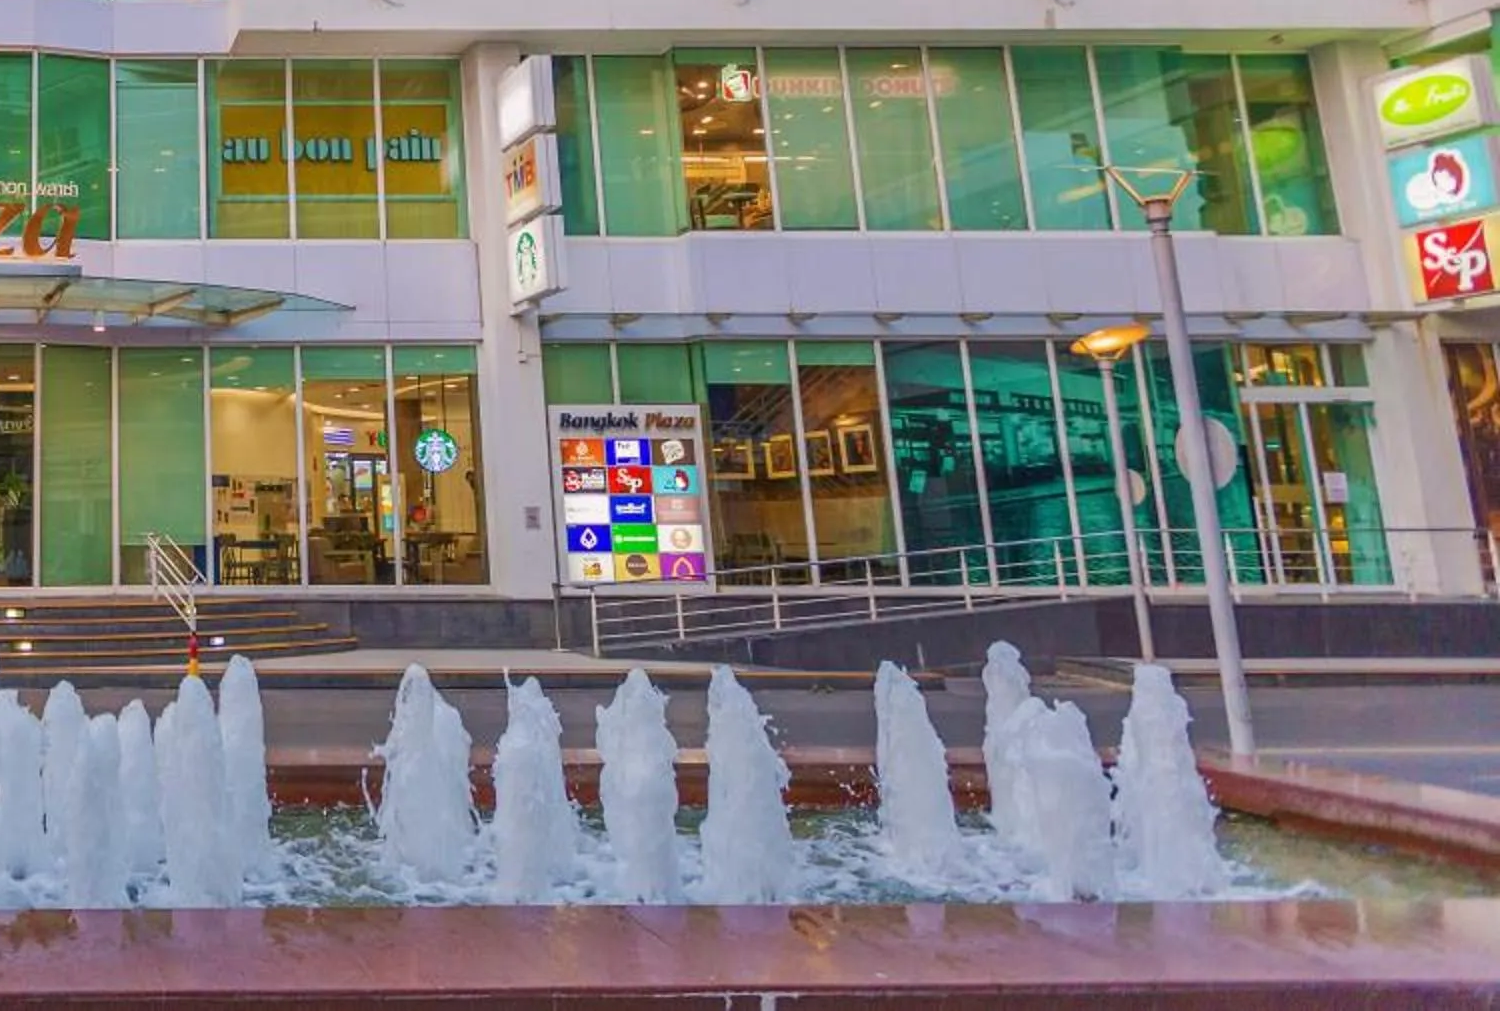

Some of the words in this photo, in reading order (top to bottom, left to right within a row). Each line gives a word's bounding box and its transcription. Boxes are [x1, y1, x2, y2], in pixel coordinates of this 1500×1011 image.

[223, 138, 270, 163] au
[280, 125, 353, 163] bon
[506, 155, 534, 199] TMB
[560, 412, 638, 431] Bangkok
[645, 412, 695, 429] Plaza
